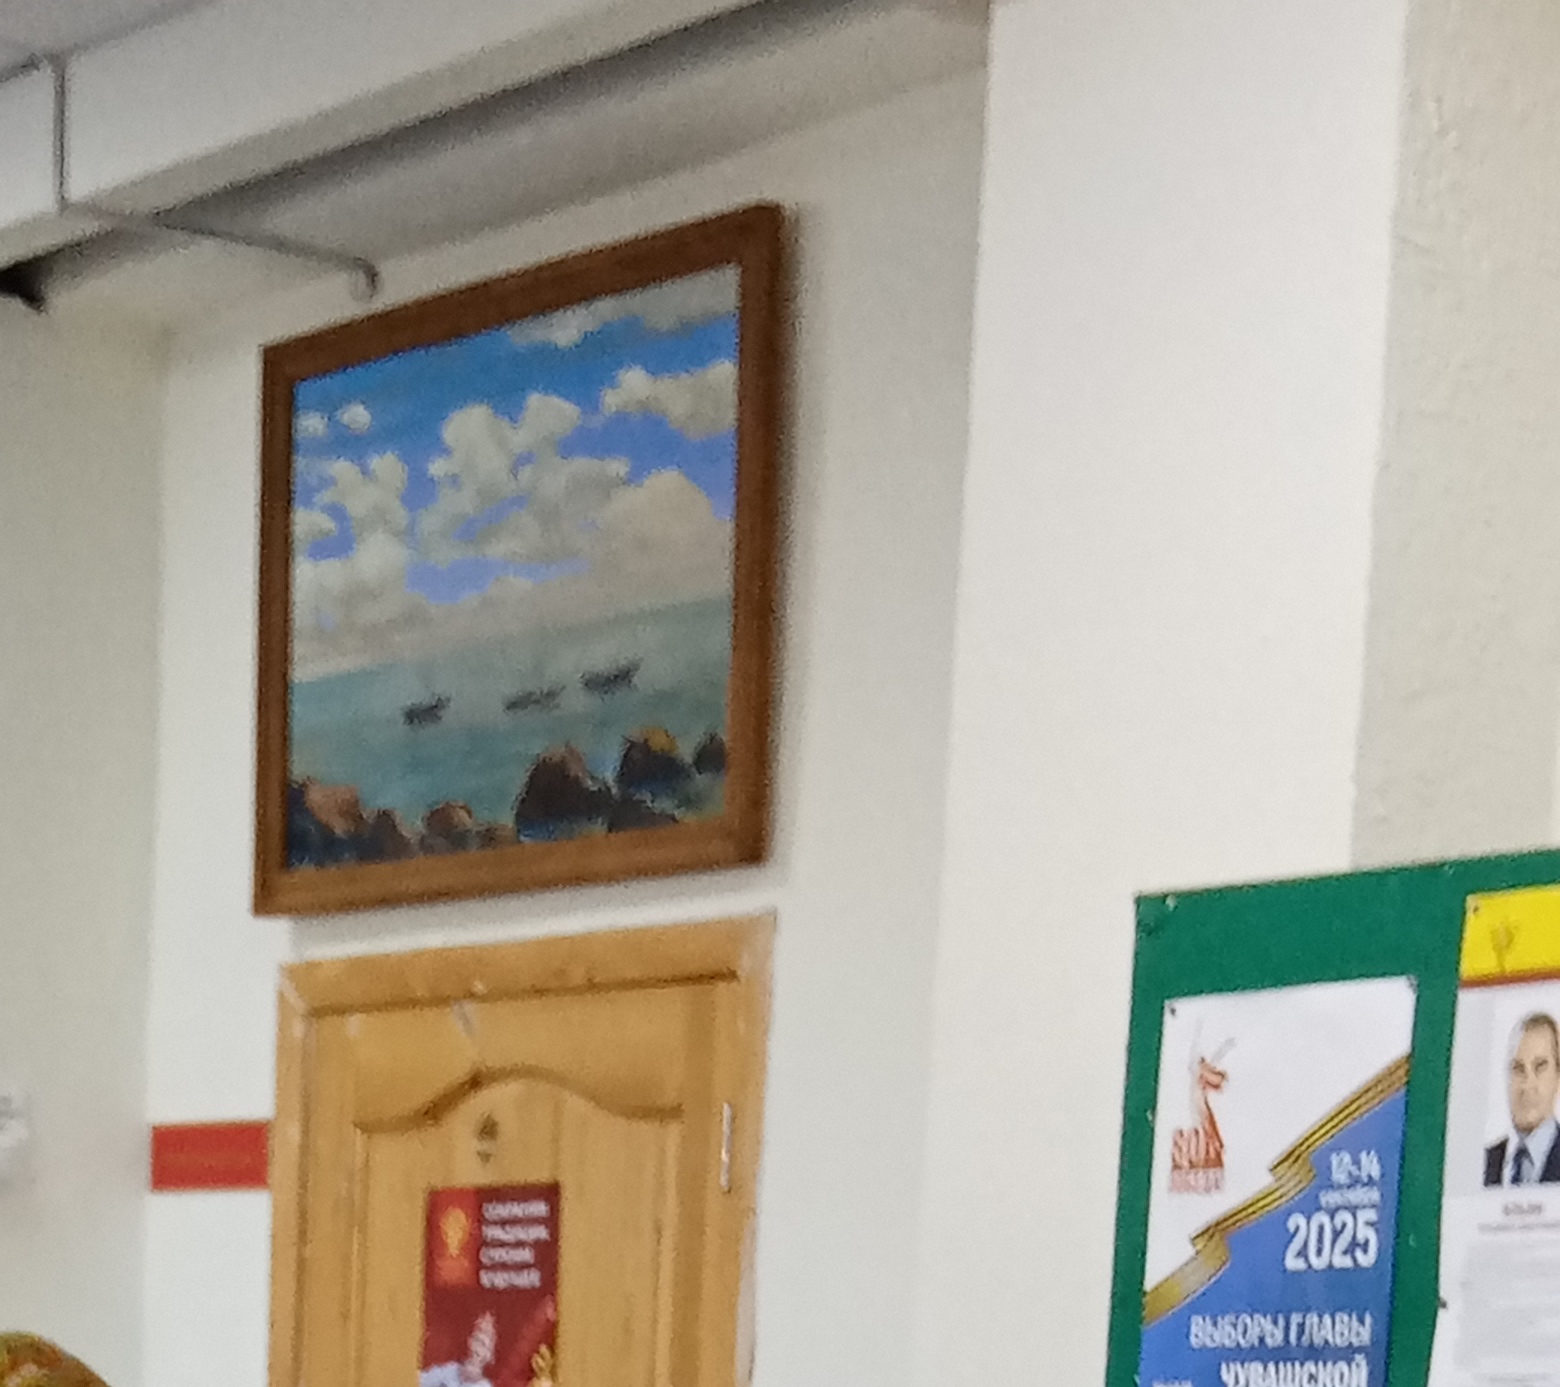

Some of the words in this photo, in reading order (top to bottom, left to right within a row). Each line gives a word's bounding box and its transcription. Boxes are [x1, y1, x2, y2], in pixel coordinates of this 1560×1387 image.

[1284, 1208, 1379, 1272] 2025
[1189, 1313, 1285, 1349] ВЫБОРЫ
[1289, 1310, 1372, 1347] ГЛАВЫ
